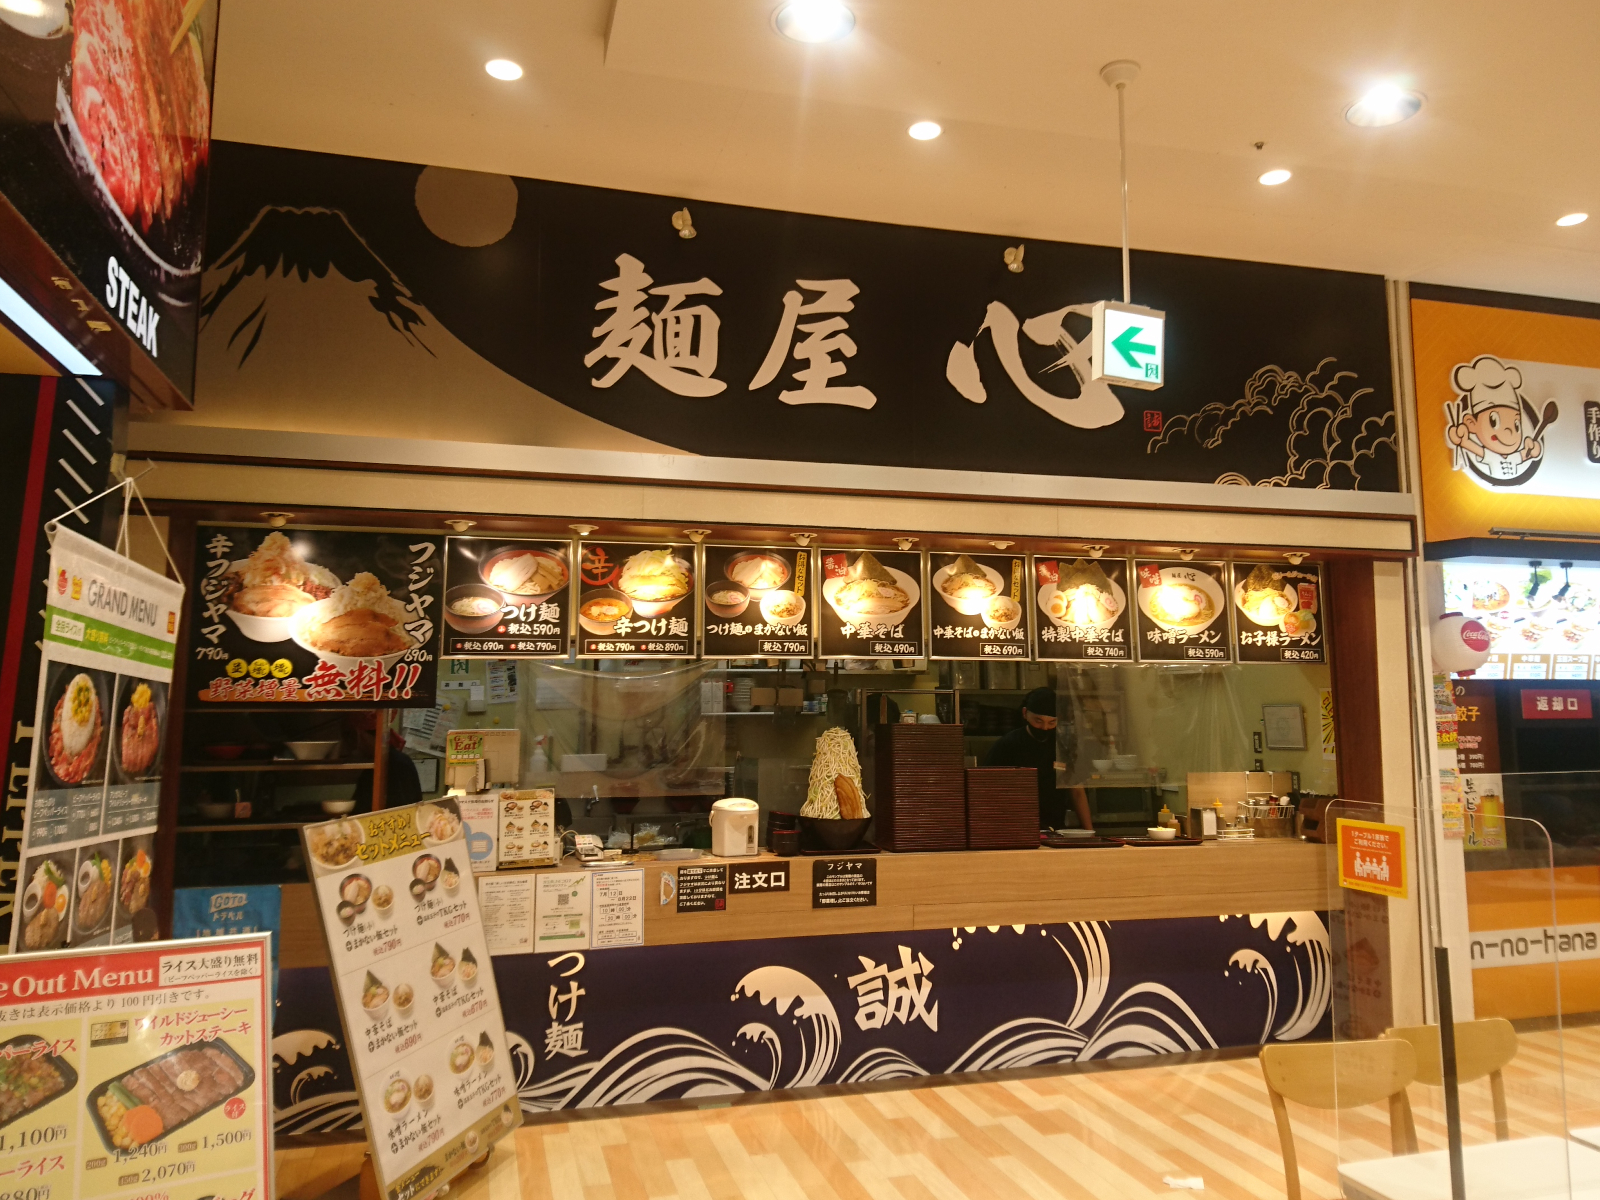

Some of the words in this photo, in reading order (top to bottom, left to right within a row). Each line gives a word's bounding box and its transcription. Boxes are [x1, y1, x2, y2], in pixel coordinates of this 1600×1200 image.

[106, 256, 160, 358] STEAK
[584, 253, 877, 409] 麺屋
[946, 300, 1125, 429] 心
[581, 546, 615, 586] 辛
[1140, 567, 1161, 585] 味噌
[201, 534, 234, 644] 辛フジヤマ
[404, 542, 436, 643] フジヤマ
[88, 579, 128, 616] GRAND
[129, 595, 159, 627] MENU
[501, 603, 560, 623] つけ麺
[508, 624, 561, 635] 税込590円
[614, 616, 688, 637] 辛つけ麺
[841, 621, 904, 639] 中華そば
[1041, 626, 1124, 643] 特製中華そば
[1147, 628, 1221, 645] 味噌ラーメン
[1240, 631, 1321, 646] お子様ラーメン
[196, 647, 229, 660] 790円
[463, 641, 504, 651] 税込690円
[517, 641, 557, 651] 税込790円
[597, 642, 635, 652] 税込790円
[647, 642, 684, 652] 税込890円
[762, 641, 806, 652] 税込790円
[874, 643, 915, 654] 税込490円
[984, 645, 1023, 655] 税込690円
[1087, 647, 1124, 657] 税込740円
[1187, 649, 1224, 658] 税込590円
[404, 650, 433, 662] 690円
[1283, 650, 1319, 660] 税込420円
[209, 677, 300, 701] 野菜増量
[1456, 685, 1465, 695] の
[1536, 696, 1579, 711] 返却口
[1456, 706, 1480, 722] 餃子
[454, 742, 478, 750] Eat
[1463, 777, 1480, 847] 生ビール
[356, 832, 432, 860] セットメニュー
[827, 862, 862, 870] フジヤマ
[734, 872, 785, 889] 注文口
[213, 911, 244, 922] トラベル
[162, 953, 258, 975] ライス大盛り無料
[13, 974, 67, 998] Out
[72, 967, 154, 991] Menu
[848, 945, 939, 1032] 誠
[544, 952, 588, 1060] つけ麺
[134, 1008, 248, 1030] ワイルドジューシー
[160, 1022, 252, 1047] カットステーキ
[113, 1143, 167, 1165] 1,240円
[202, 1131, 251, 1151] 1,500円
[141, 1163, 195, 1183] 2,070円
